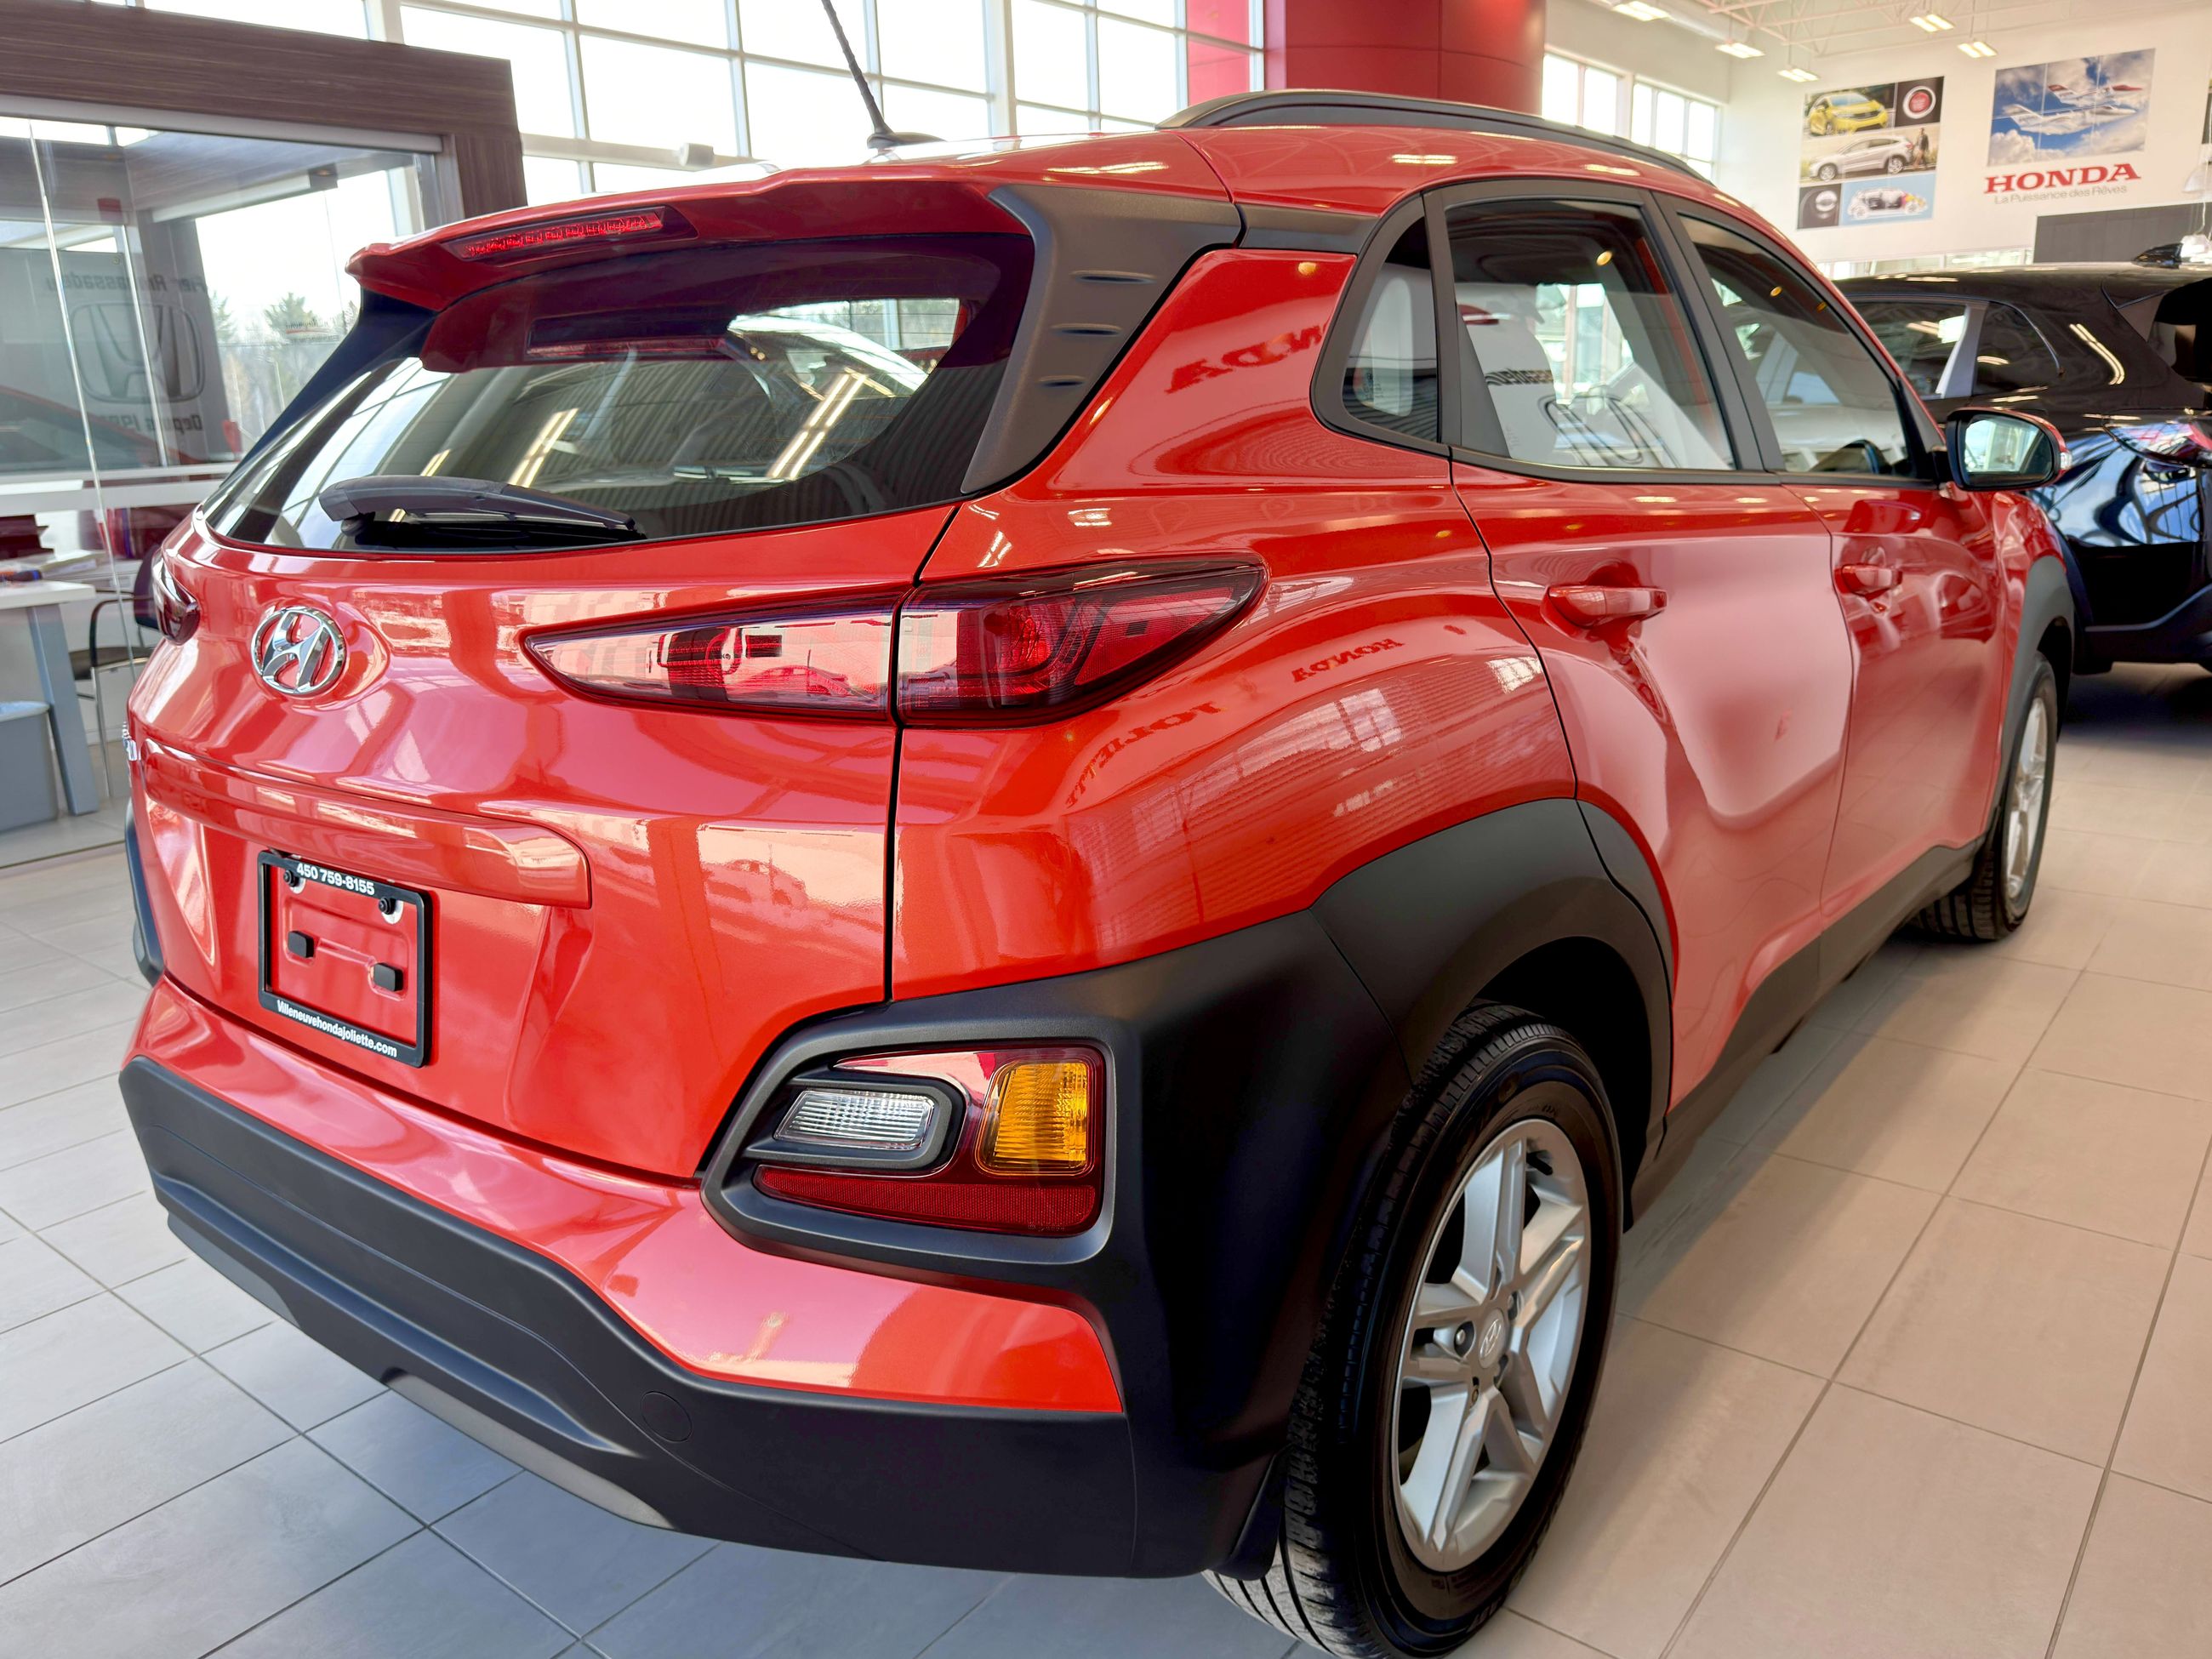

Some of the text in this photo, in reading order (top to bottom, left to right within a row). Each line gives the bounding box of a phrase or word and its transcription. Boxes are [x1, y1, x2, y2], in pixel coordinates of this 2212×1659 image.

[1984, 163, 2141, 194] HONDA
[1994, 185, 2128, 204] La Puissance des Rêves
[296, 863, 375, 896] 450 759-8155
[277, 1000, 397, 1058] Villeneuvehondajoliette.com
